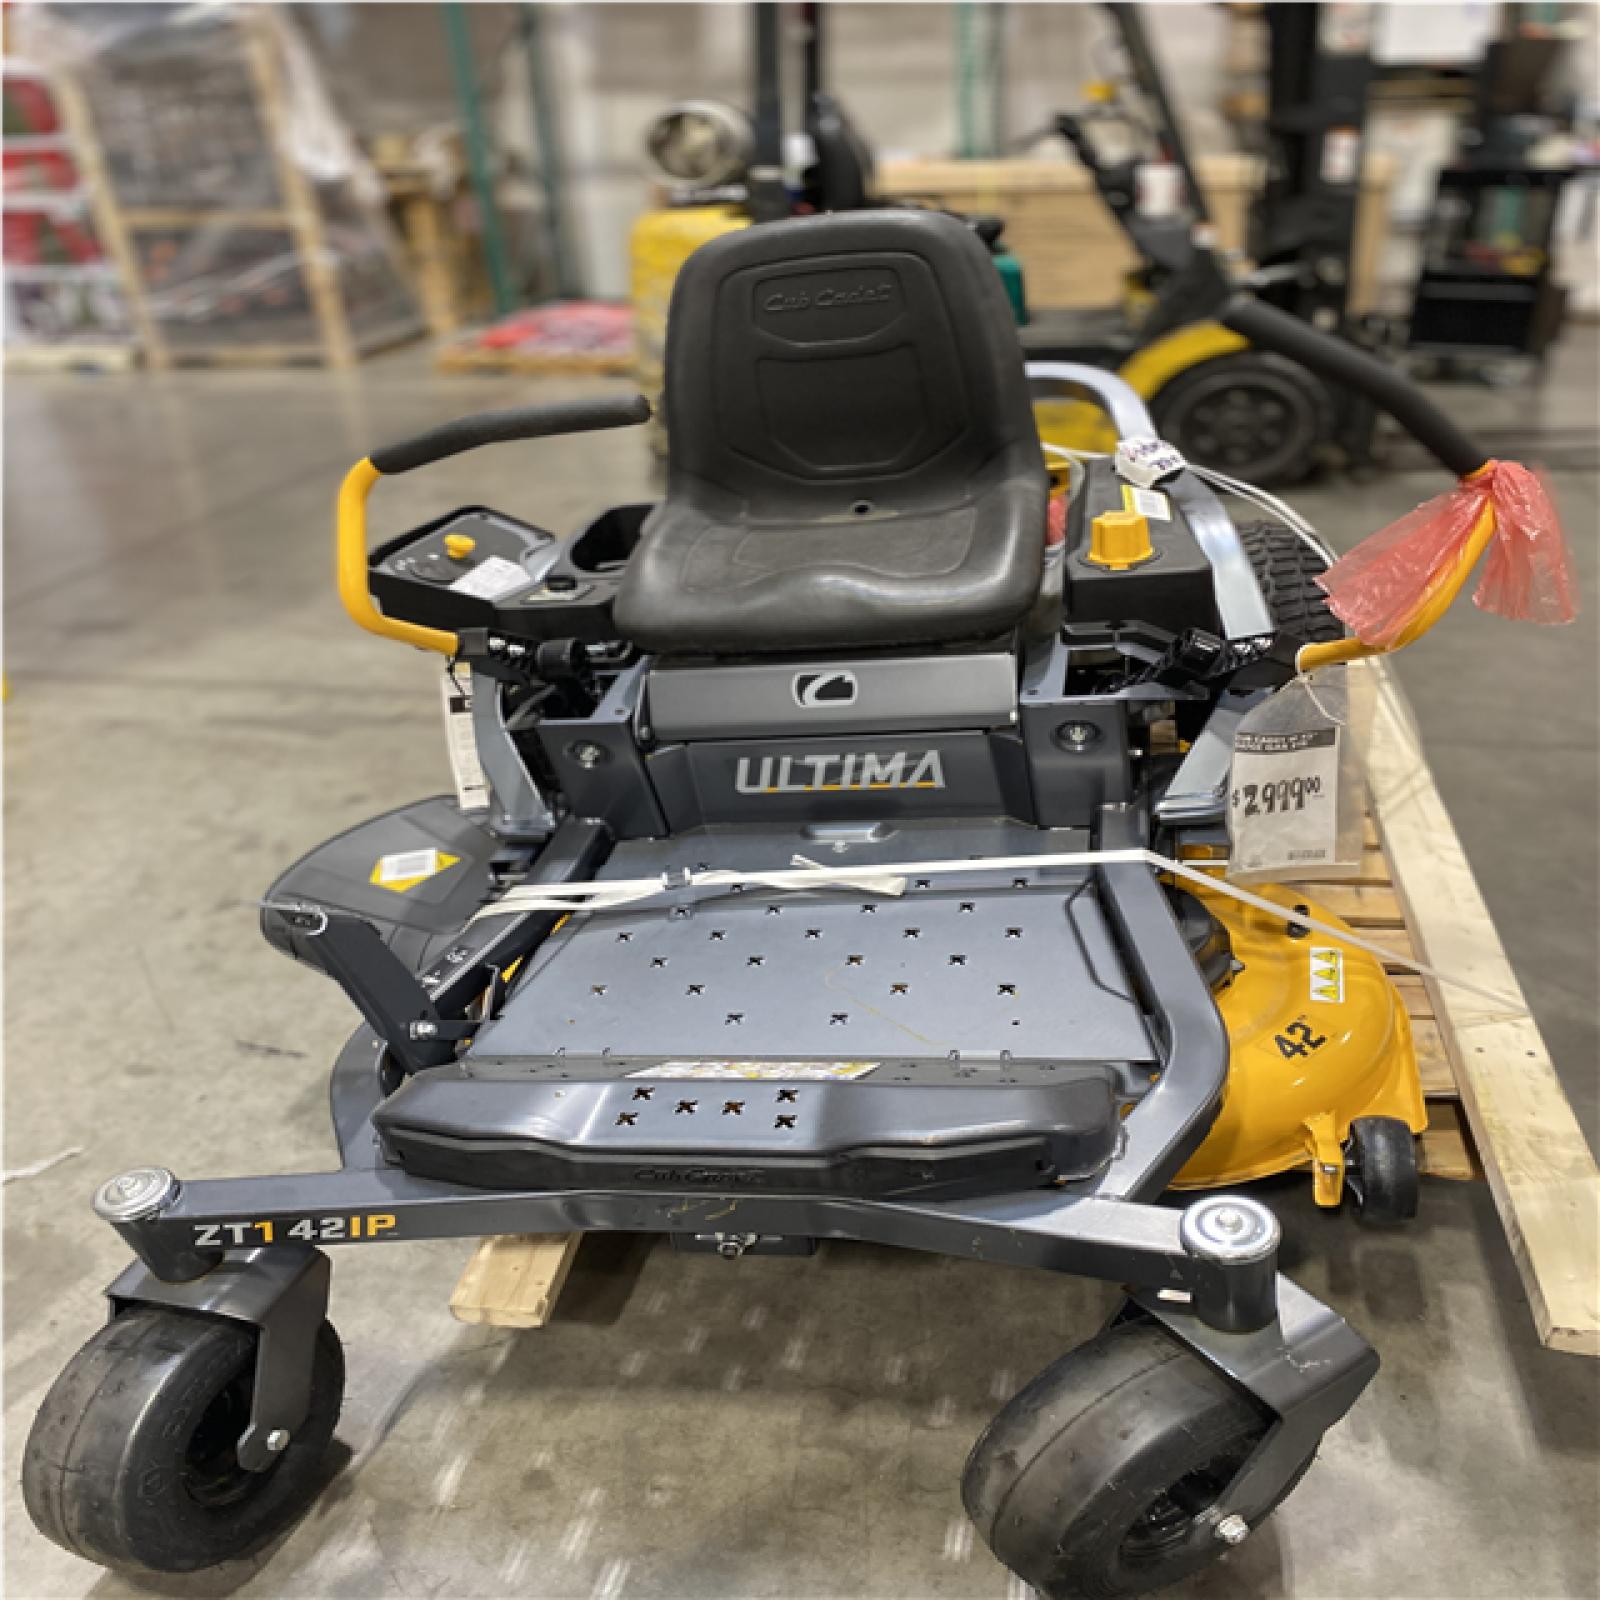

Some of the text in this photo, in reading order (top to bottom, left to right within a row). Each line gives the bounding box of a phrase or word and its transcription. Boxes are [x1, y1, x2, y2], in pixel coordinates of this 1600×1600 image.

[764, 291, 811, 312] Cub
[735, 749, 945, 793] ULTIMA
[193, 1213, 397, 1247] ZT1 42IP
